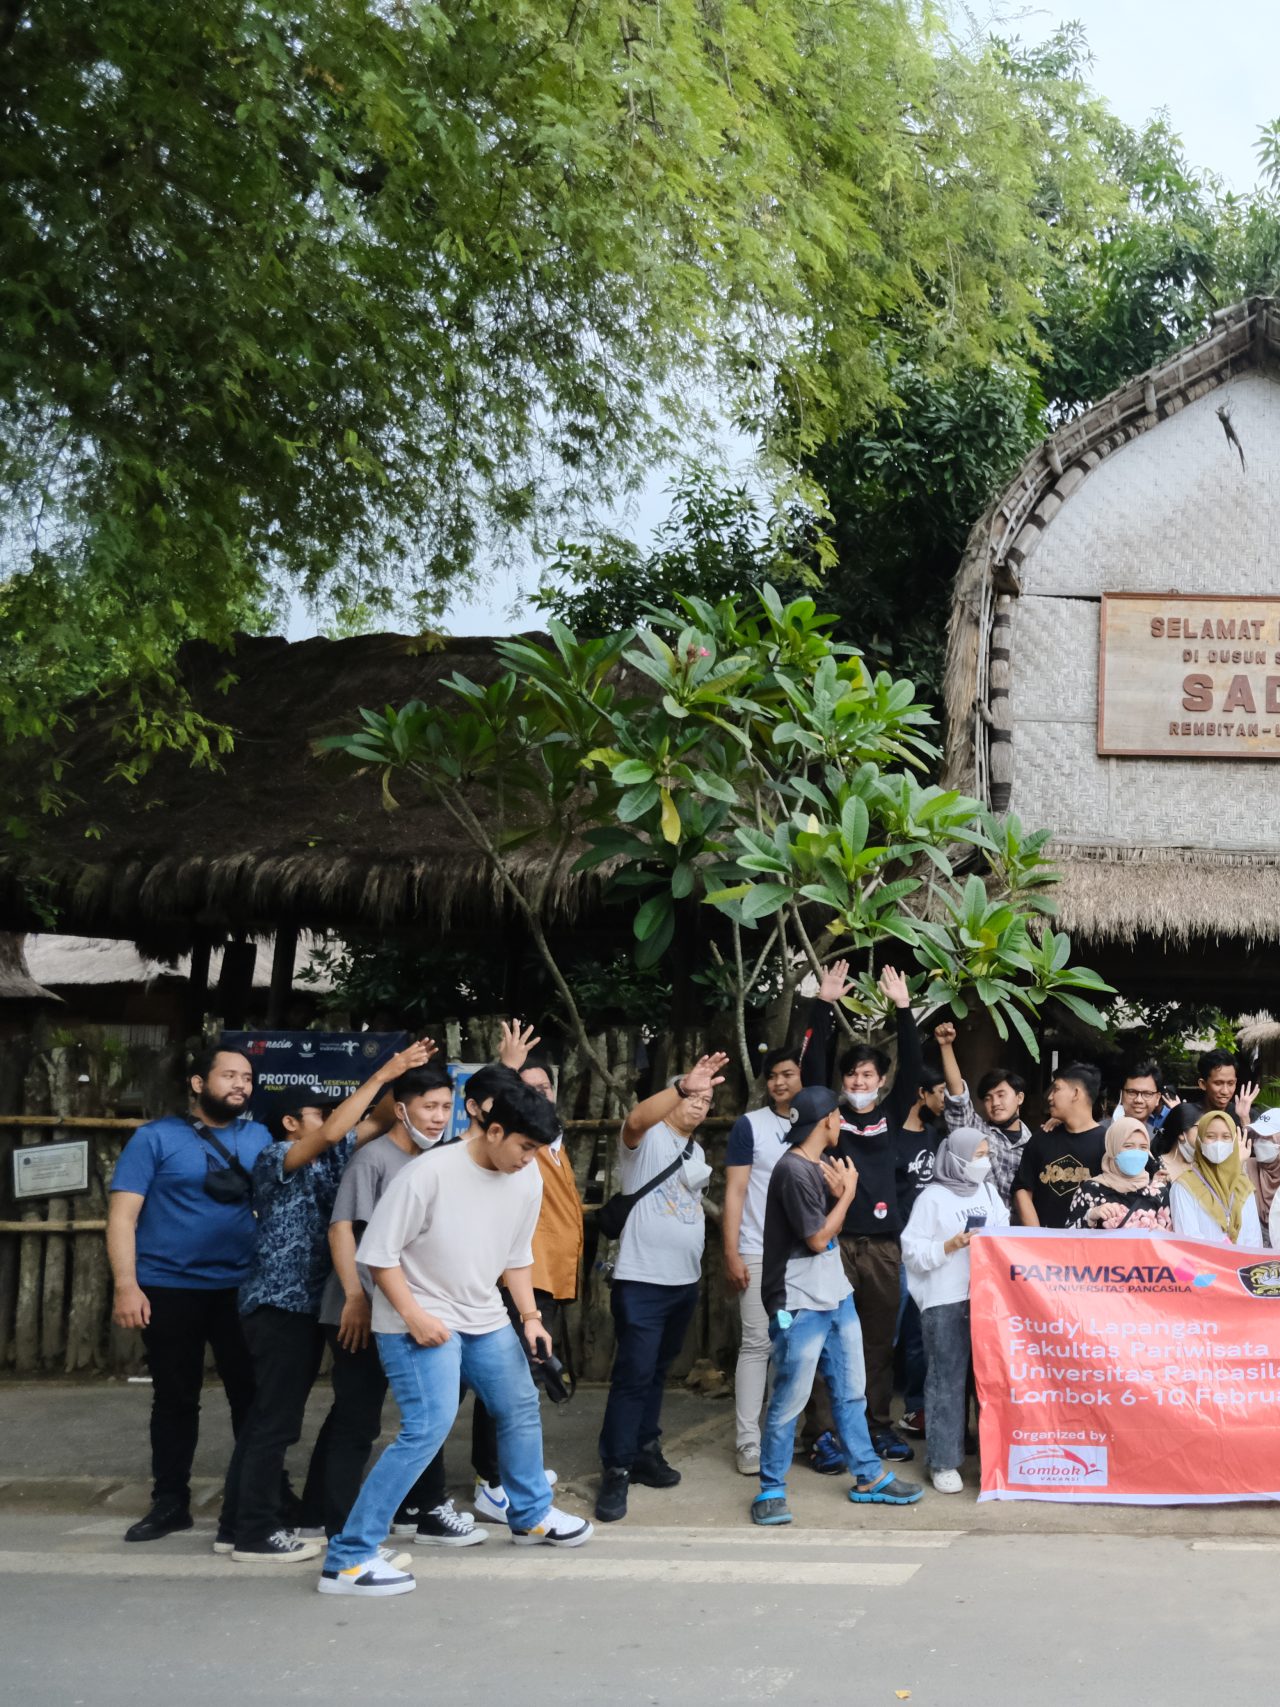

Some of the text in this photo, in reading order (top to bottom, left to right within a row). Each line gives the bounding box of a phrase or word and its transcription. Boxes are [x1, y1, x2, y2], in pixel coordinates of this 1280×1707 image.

[1150, 617, 1265, 640] SELAMAT
[1183, 649, 1199, 663] DI
[1208, 650, 1266, 665] DUSUN
[259, 1073, 322, 1086] PROTOKOL
[1010, 1264, 1177, 1283] PARIWISATA
[1049, 1284, 1192, 1293] UNIVERSITAS PANCASILA
[1008, 1315, 1218, 1339] Study Lapangan
[1009, 1340, 1269, 1359] Fakultas Pariwisata
[1010, 1363, 1154, 1382] Universitas
[1010, 1388, 1112, 1406] Lombok
[1012, 1429, 1086, 1442] Organized
[1018, 1465, 1081, 1476] Lombok
